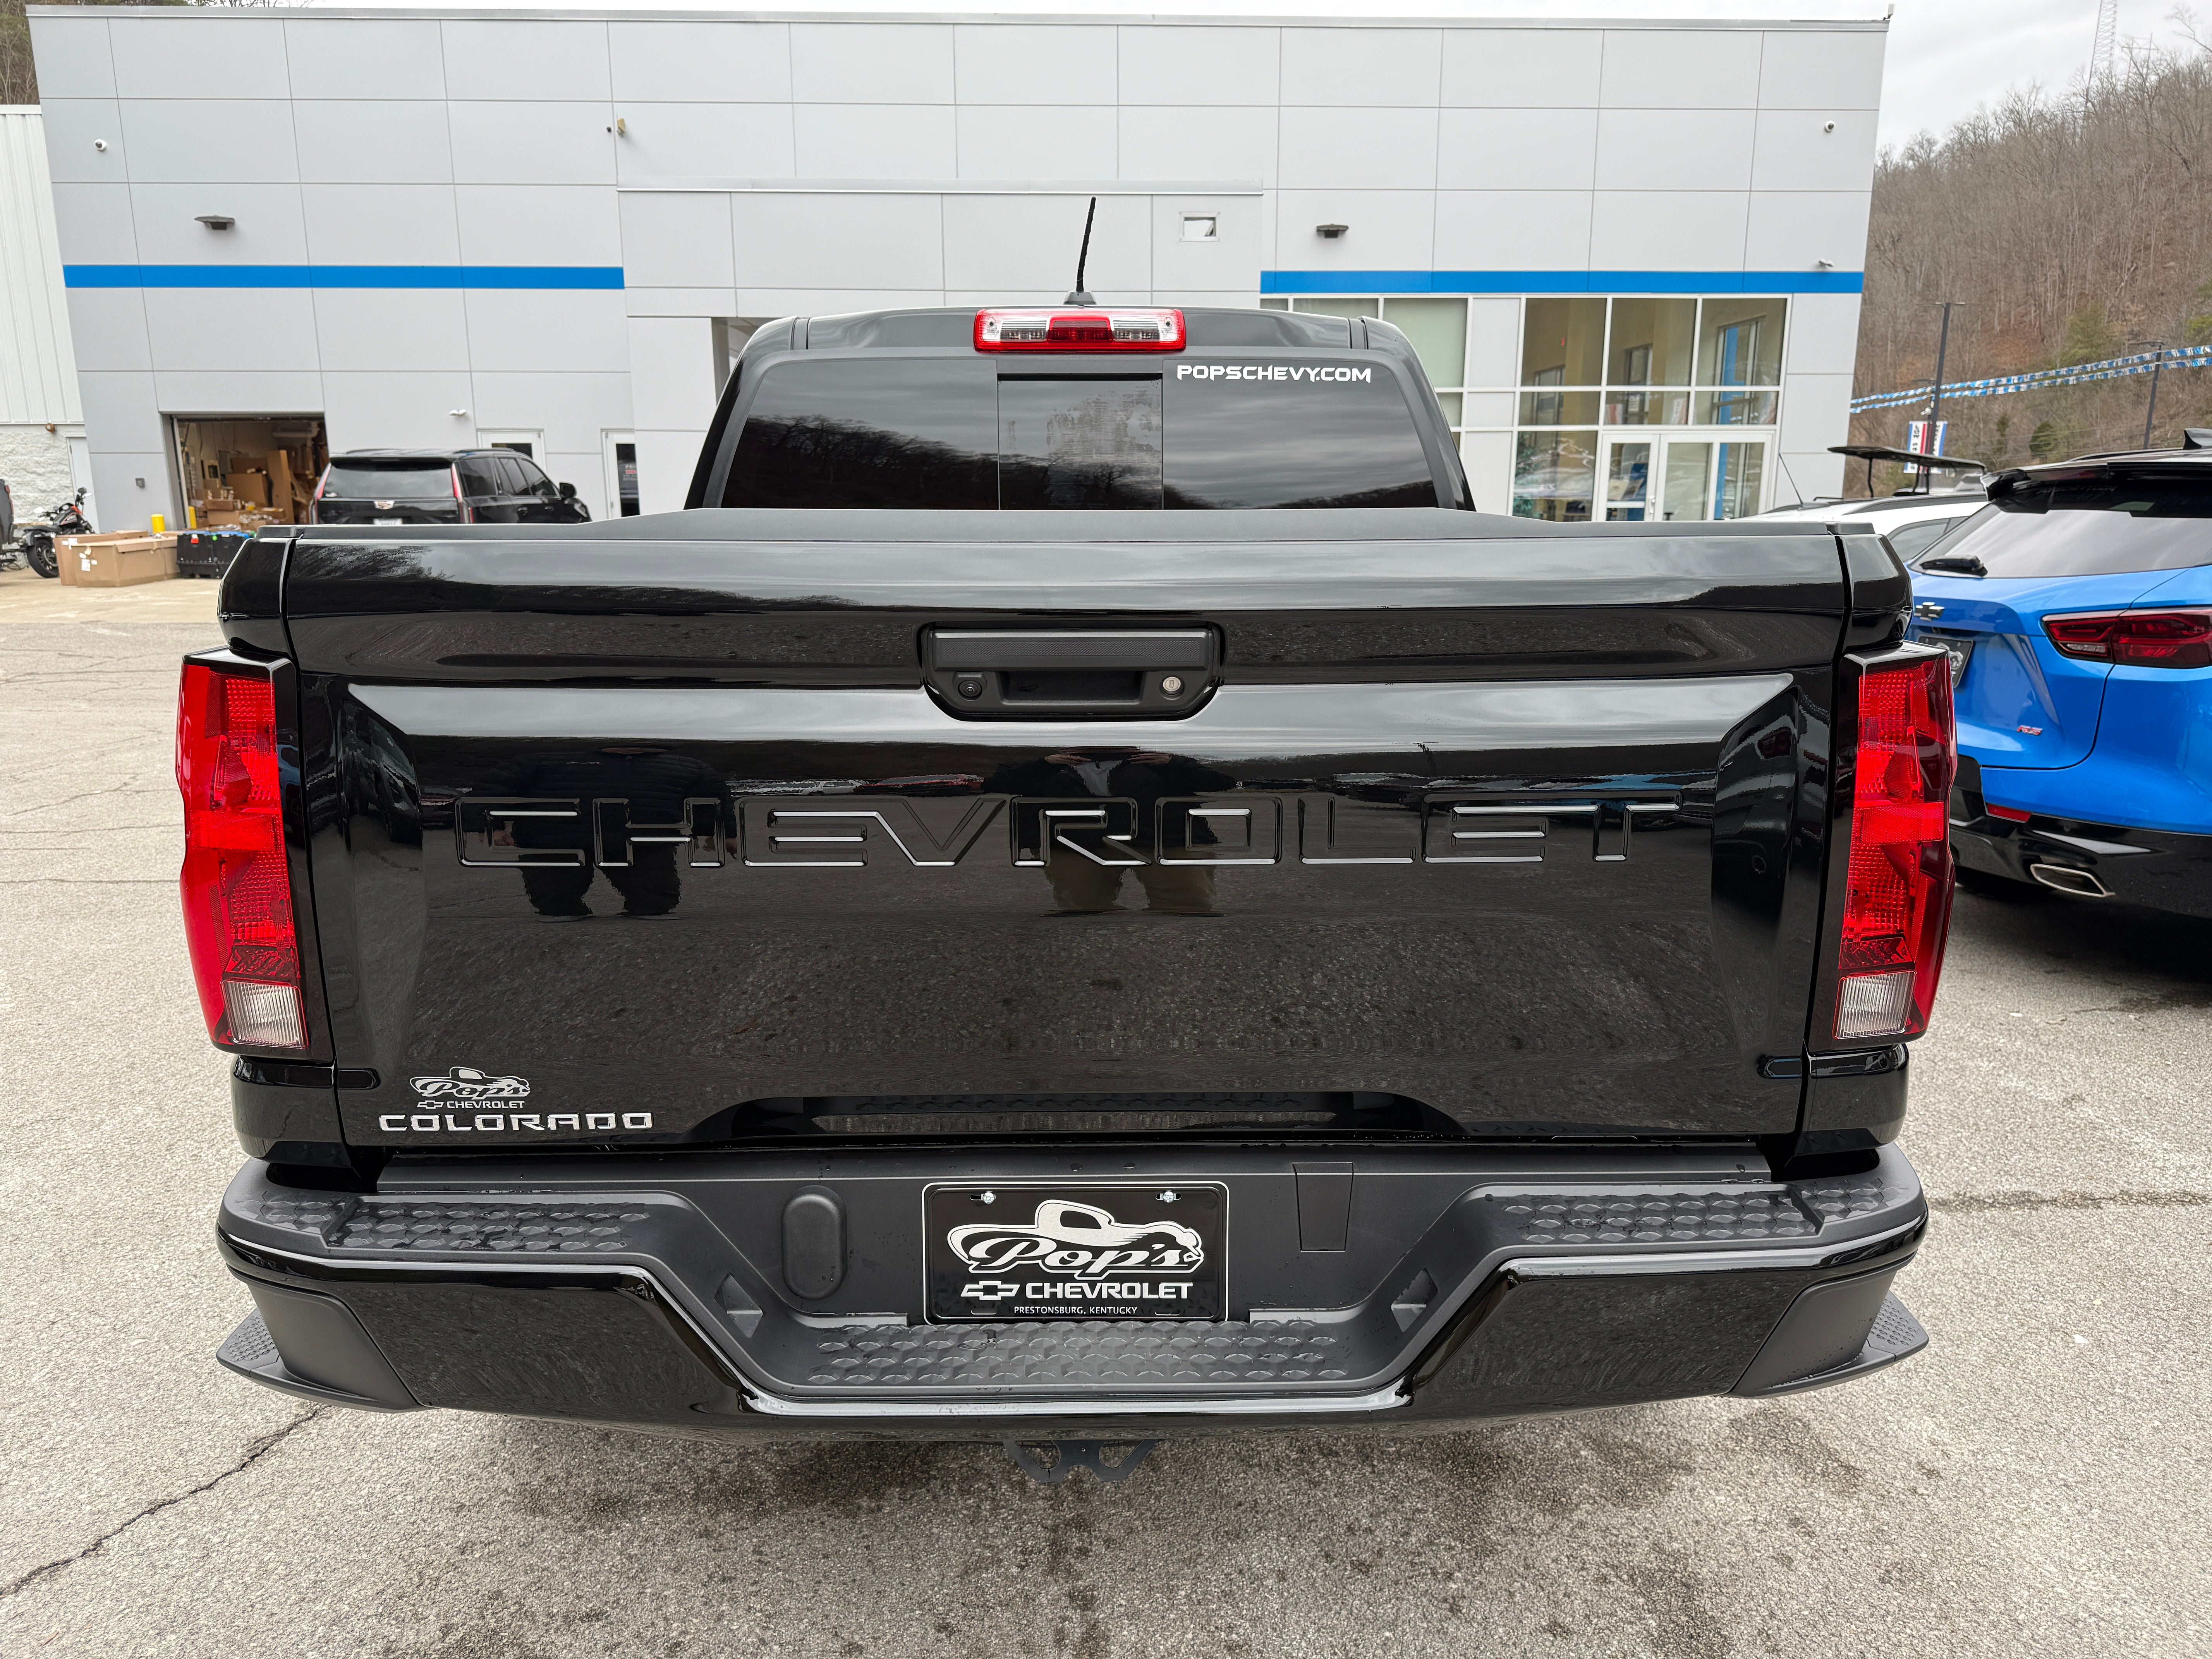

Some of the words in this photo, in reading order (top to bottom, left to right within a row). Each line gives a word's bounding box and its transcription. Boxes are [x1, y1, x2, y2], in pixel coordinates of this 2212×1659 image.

[1176, 365, 1371, 383] POPSCHEVY.COM
[455, 790, 1683, 867] CHEVROLET
[447, 1101, 525, 1109] CHEVROLET
[379, 1113, 653, 1131] COLORADO
[969, 1237, 1189, 1273] Pop's
[1025, 1282, 1194, 1299] CHEVROLET
[1014, 1305, 1087, 1316] PRESTONSBURG,
[1089, 1305, 1138, 1315] KENTUCKY
